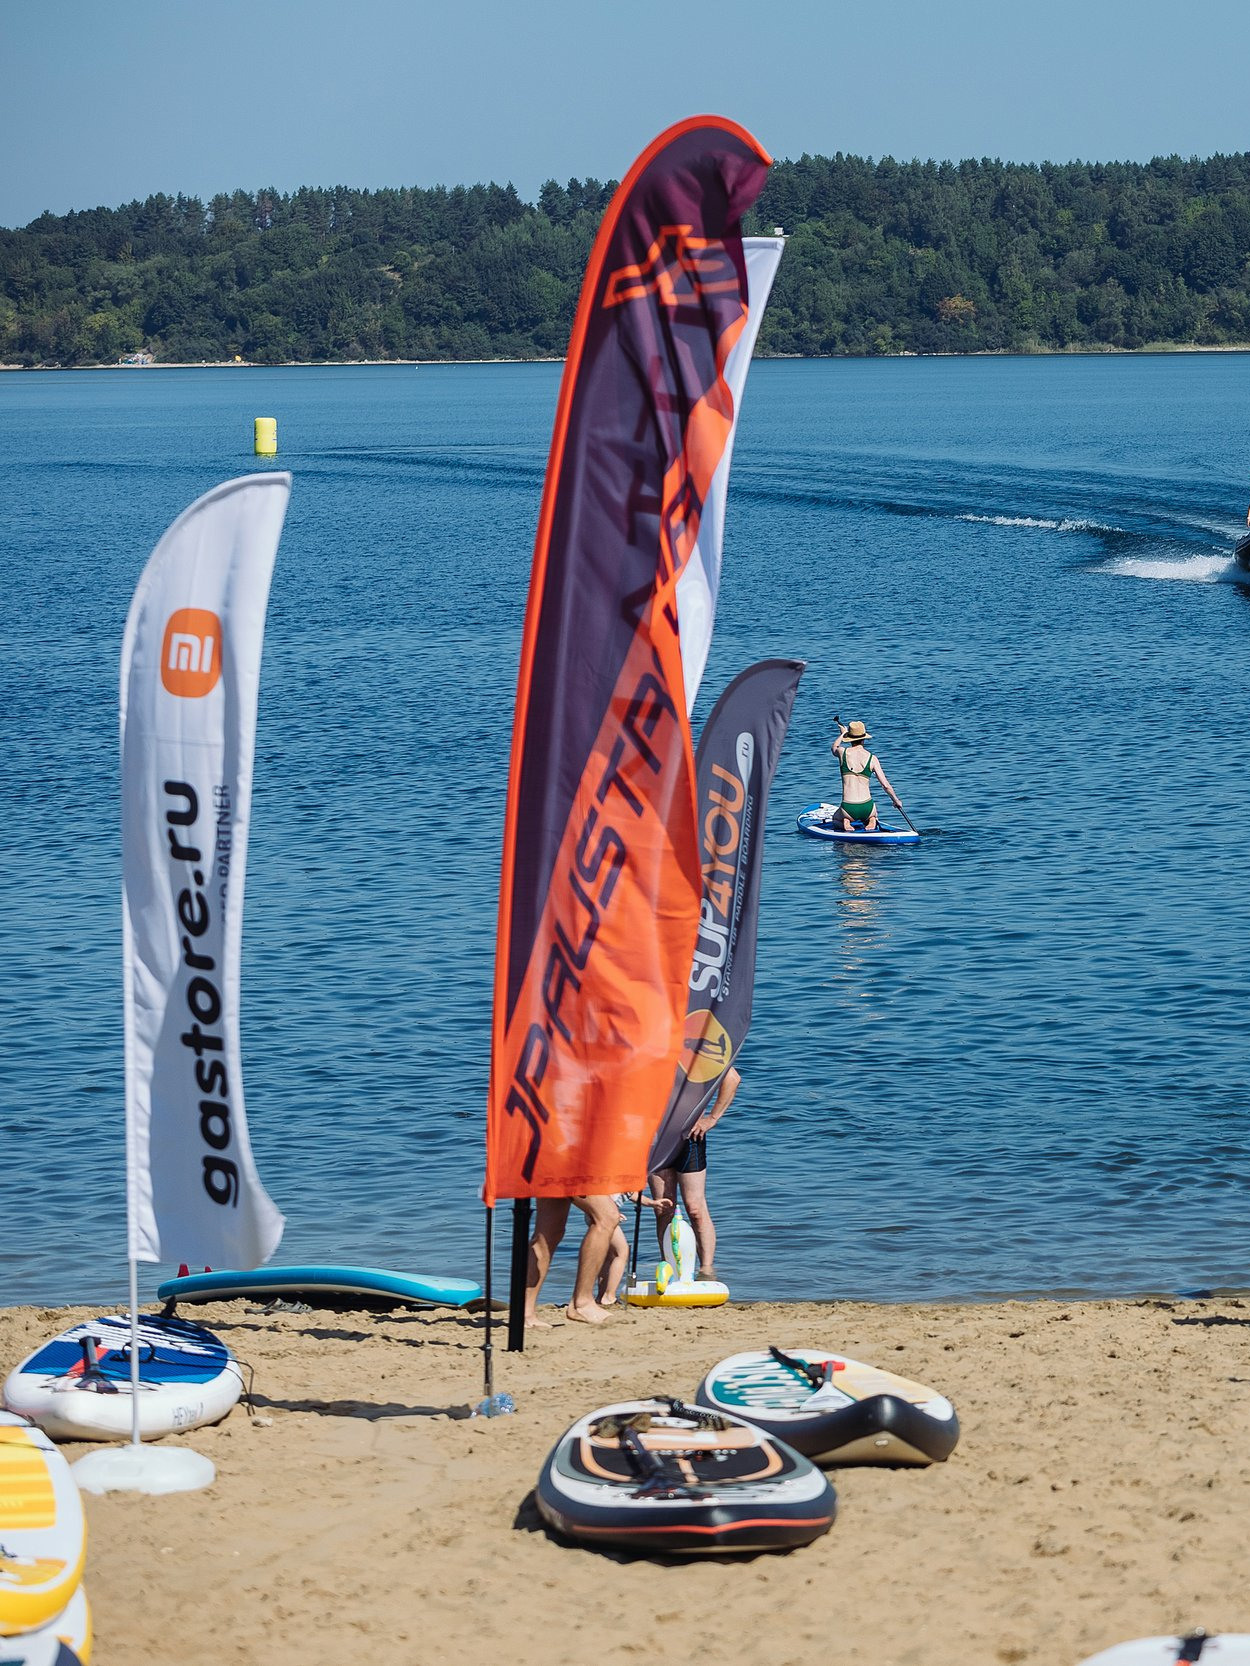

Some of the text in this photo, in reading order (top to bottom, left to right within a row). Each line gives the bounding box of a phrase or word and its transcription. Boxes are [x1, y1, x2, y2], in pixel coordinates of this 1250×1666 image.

[213, 784, 233, 881] PARTNER
[689, 763, 745, 999] SUP4YOU
[735, 871, 747, 921] PADDLE
[741, 795, 754, 864] BOARDING
[164, 781, 238, 1207] gastore.ru
